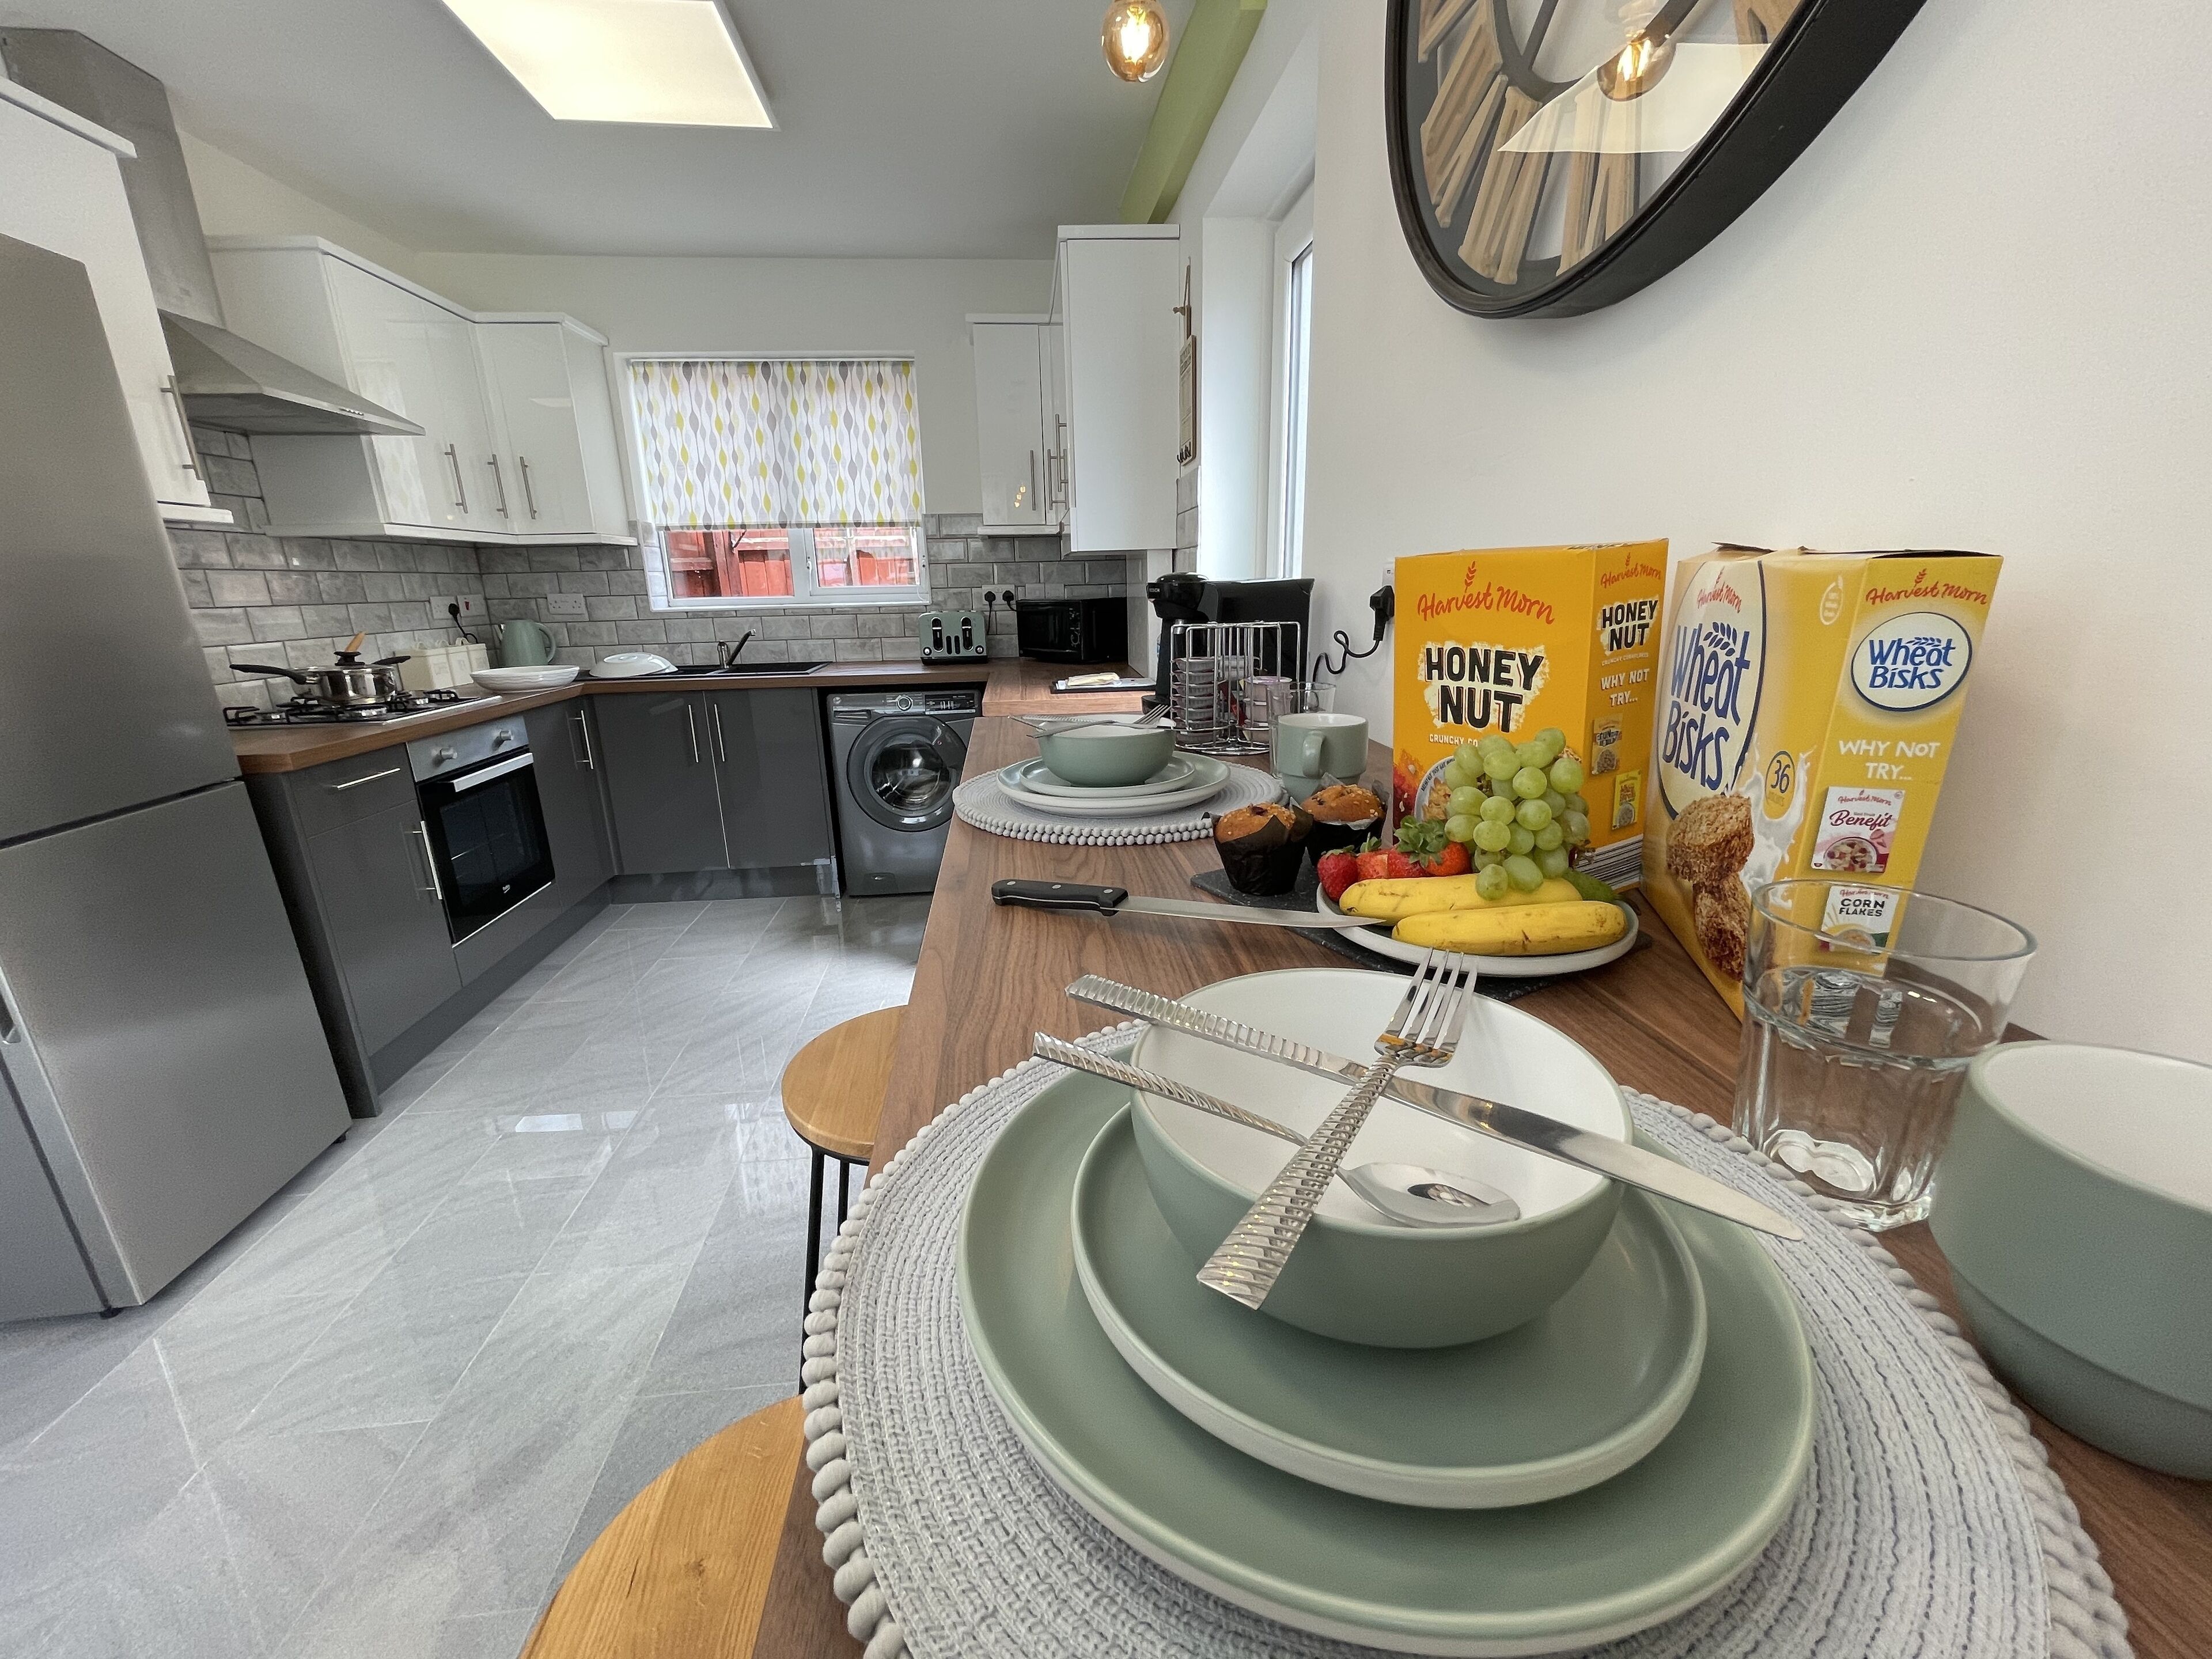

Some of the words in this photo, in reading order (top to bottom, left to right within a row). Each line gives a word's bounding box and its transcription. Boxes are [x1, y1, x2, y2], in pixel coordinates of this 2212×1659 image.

[1601, 563, 1639, 588] Harvest
[1640, 564, 1661, 579] Morn
[1417, 581, 1494, 621] Harvest
[1497, 586, 1555, 624] Morn
[1866, 581, 1940, 605] Harvest
[1941, 583, 1987, 605] Morn
[1602, 600, 1658, 628] HONEY
[1609, 622, 1649, 652] NUT
[1869, 637, 1956, 666] Wheat
[1425, 646, 1544, 691] HONEY
[1601, 673, 1626, 690] WHY
[1629, 669, 1650, 684] NOT
[1671, 623, 1751, 726] Wheat
[1869, 666, 1944, 689] Bisks
[1438, 685, 1524, 733] NUT
[1610, 691, 1638, 707] TRY...
[1429, 734, 1464, 745] CRUNCHY
[1662, 700, 1730, 790] Bisks
[1839, 740, 1891, 756] WHY
[1895, 741, 1941, 758] NOT
[1771, 759, 1790, 793] 36
[1865, 762, 1912, 781] TRY...
[1838, 795, 1870, 804] Harvest
[1870, 796, 1892, 806] Morn
[1830, 809, 1893, 831] Benefit
[1839, 907, 1883, 916] FLAKES
[1840, 898, 1885, 910] CORN
